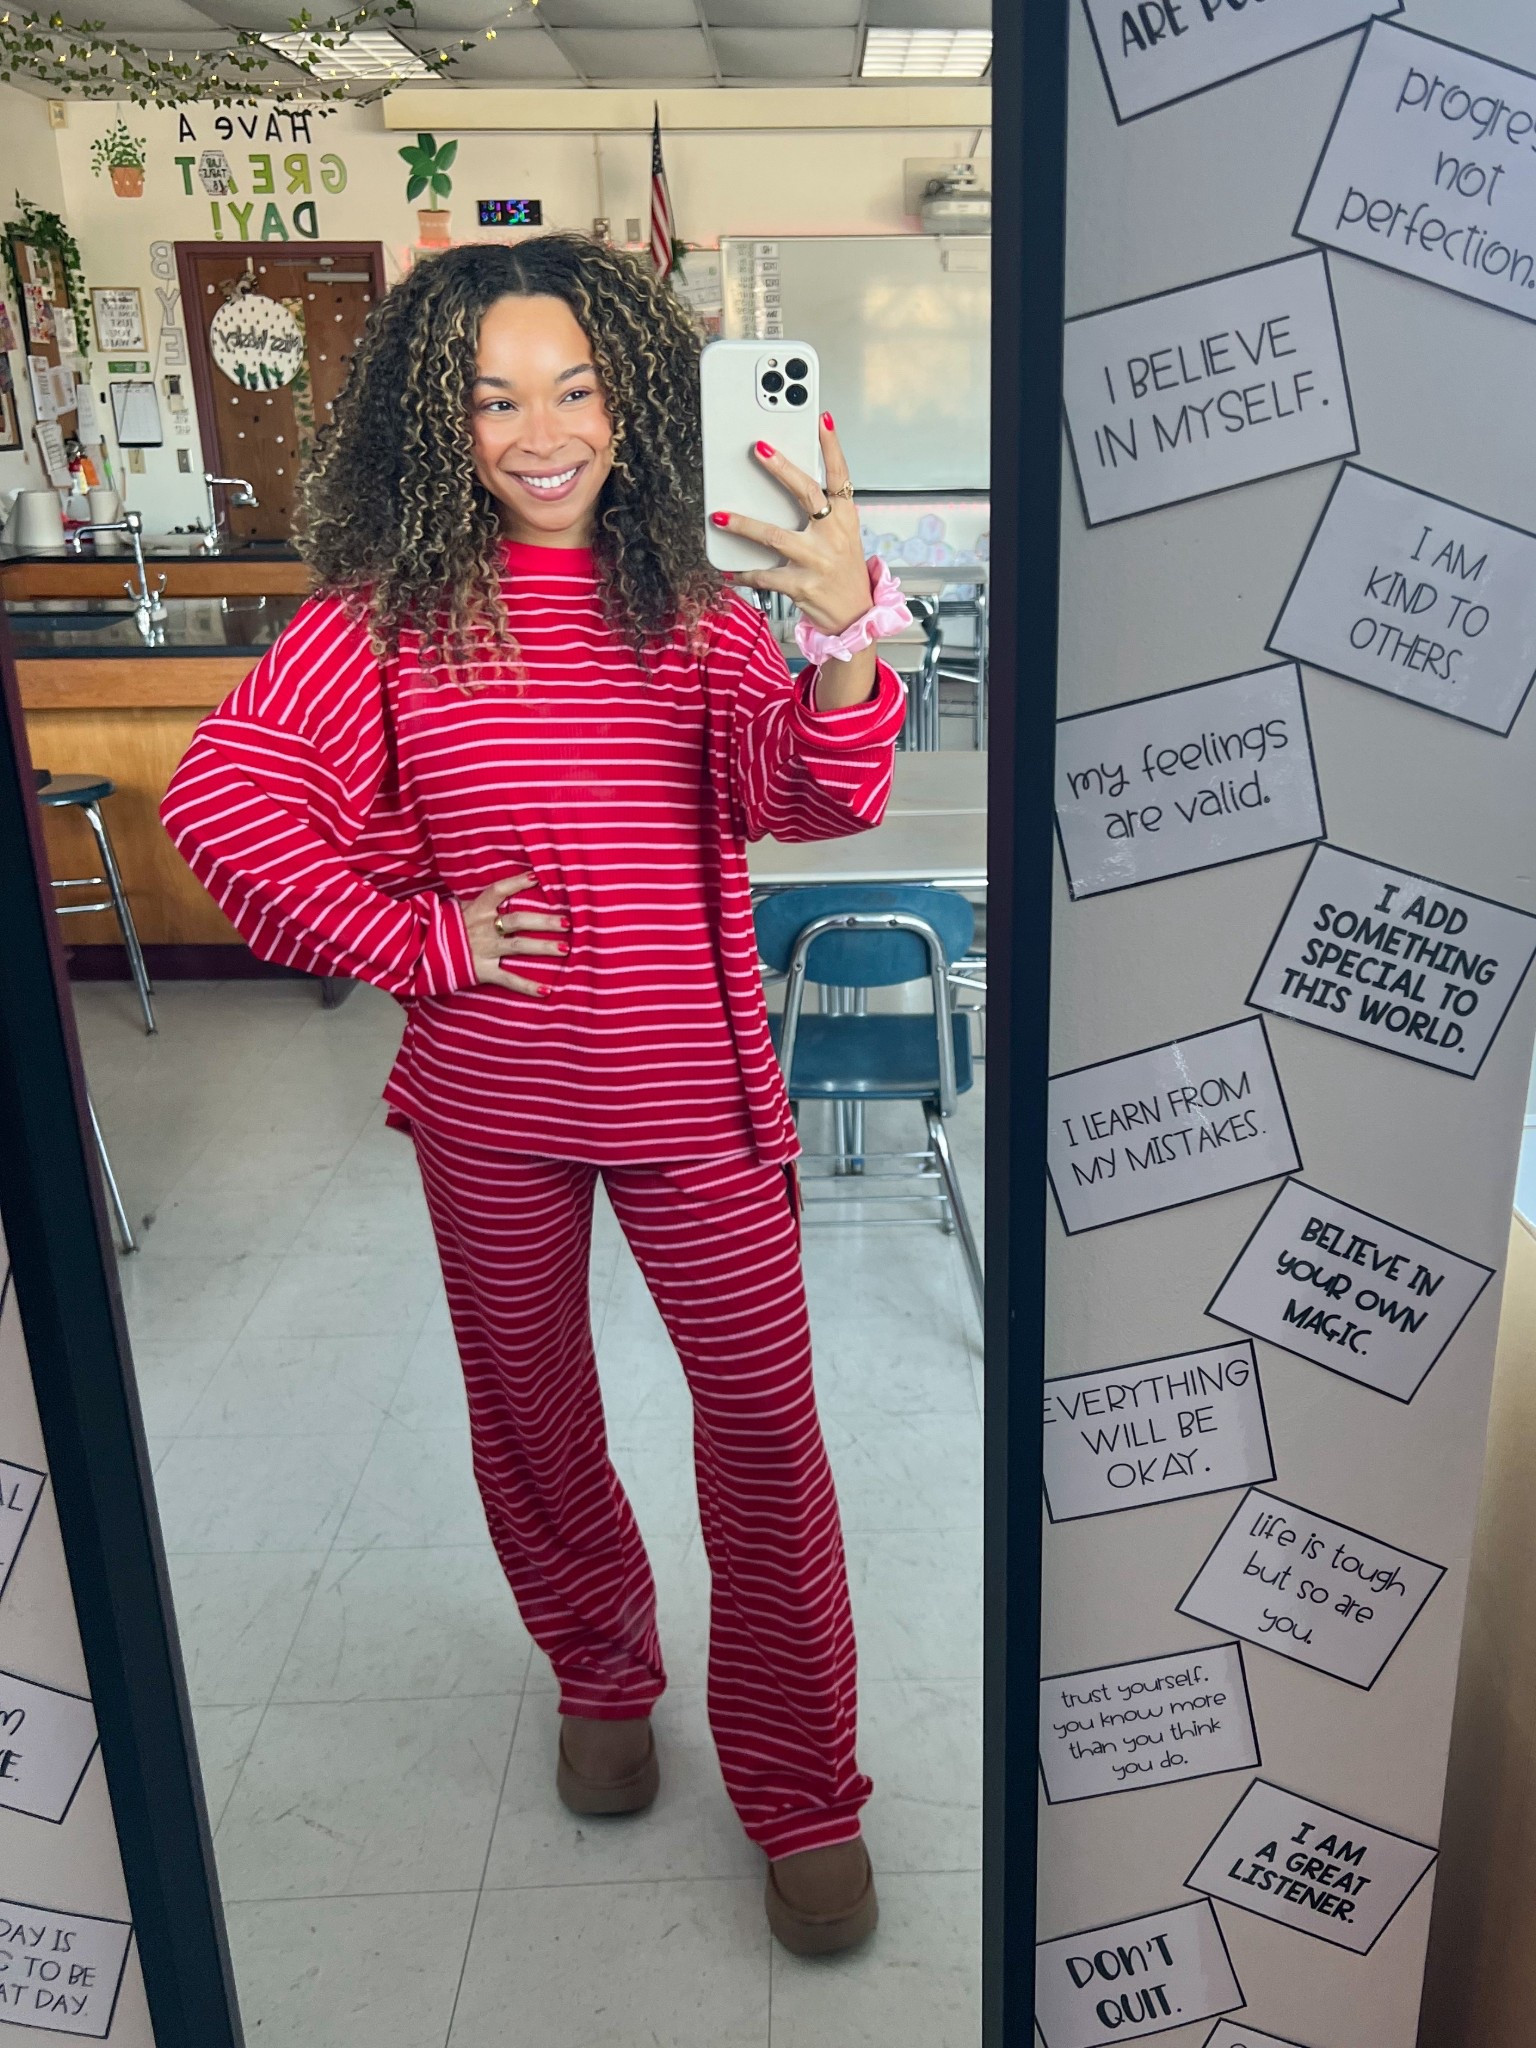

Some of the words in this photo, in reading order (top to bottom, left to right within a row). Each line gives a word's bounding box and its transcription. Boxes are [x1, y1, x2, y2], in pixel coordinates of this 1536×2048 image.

[1120, 0, 1188, 57] ARE
[1434, 151, 1505, 206] not
[1335, 186, 1536, 289] perfection.
[1104, 366, 1116, 404] I
[1127, 315, 1297, 399] BELIEVE
[1094, 418, 1138, 468] IN
[1152, 370, 1329, 453] MYSELF.
[1410, 526, 1432, 561] I
[1430, 540, 1489, 582] AM
[1364, 566, 1437, 615] KIND
[1446, 595, 1490, 638] TO
[1350, 617, 1463, 684] OTHERS.
[1067, 762, 1130, 800] my
[1141, 719, 1289, 782] feelings
[1105, 806, 1162, 839] are
[1174, 770, 1271, 823] valid.
[1374, 883, 1399, 914] I
[1401, 895, 1468, 936] ADD
[1313, 904, 1499, 986] SOMETHING
[1301, 938, 1426, 1002] SPECIAL
[1439, 982, 1479, 1017] TO
[1280, 968, 1352, 1014] THIS
[1358, 996, 1466, 1054] WORLD.
[1062, 1119, 1079, 1147] I
[1082, 1096, 1161, 1140] LEARN
[1167, 1071, 1251, 1118] FROM
[1071, 1148, 1117, 1187] MY
[1125, 1109, 1266, 1172] MISTAKES.
[1300, 1216, 1411, 1281] BELIEVE
[1407, 1264, 1445, 1298] IN
[1282, 1298, 1373, 1356] MAGIC.
[1355, 1288, 1428, 1335] OWN
[1081, 1418, 1167, 1455] WILL
[1177, 1405, 1218, 1438] BE
[1106, 1447, 1211, 1489] OKAY.
[1249, 1511, 1297, 1547] life
[1301, 1533, 1325, 1560] is
[1331, 1543, 1406, 1597] tough
[1243, 1550, 1291, 1592] but
[1297, 1579, 1328, 1604] so
[1334, 1594, 1374, 1623] are
[1258, 1608, 1312, 1644] you.
[1053, 1717, 1094, 1739] you
[1099, 1707, 1164, 1729] know
[1170, 1690, 1227, 1716] more
[1061, 1683, 1112, 1709] trust
[1117, 1665, 1210, 1702] yourself.
[1068, 1738, 1117, 1761] than
[1122, 1732, 1164, 1754] you
[1169, 1718, 1222, 1742] think
[1112, 1760, 1153, 1780] you
[1160, 1752, 1188, 1769] do.
[1255, 1840, 1278, 1863] A
[1285, 1852, 1372, 1897] GREAT
[1290, 1822, 1315, 1846] I
[1315, 1834, 1367, 1866] AM
[1227, 1858, 1355, 1925] LISTENER.
[51, 1929, 77, 1952] IS
[24, 1956, 61, 1981] TO
[69, 1964, 96, 1987] BE
[36, 1989, 88, 2016] DAY.
[1095, 1984, 1182, 2029] QUIT.
